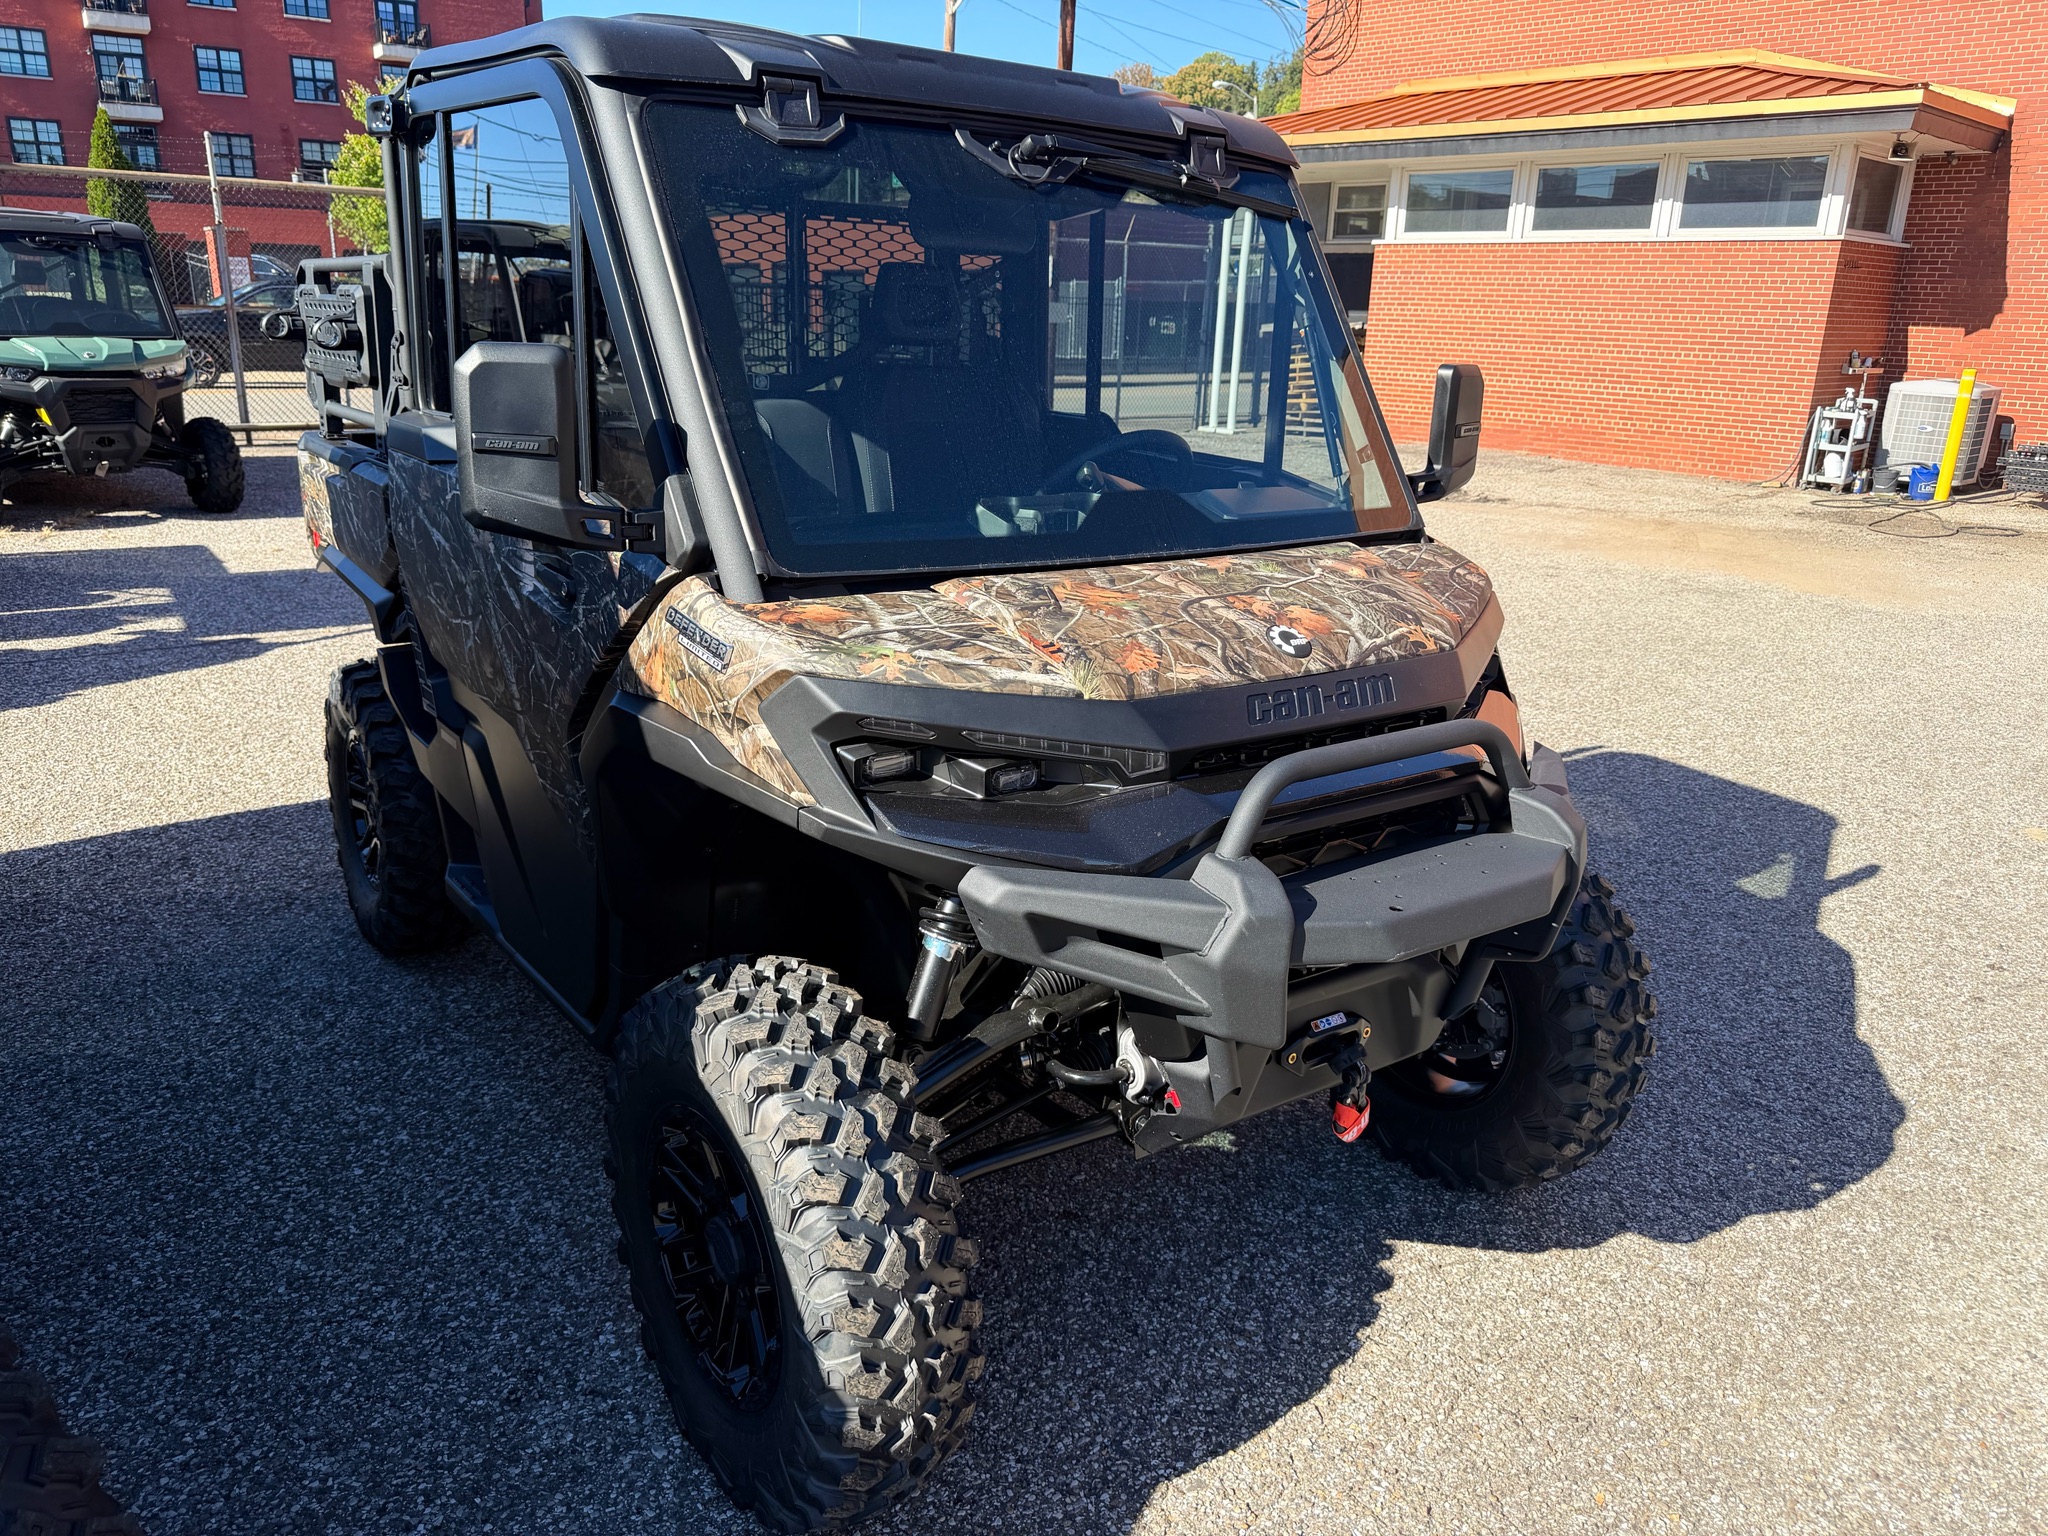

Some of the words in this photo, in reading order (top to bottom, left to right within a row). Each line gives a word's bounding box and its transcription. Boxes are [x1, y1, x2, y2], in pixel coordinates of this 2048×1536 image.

[485, 439, 540, 451] can-am
[666, 608, 727, 658] DEFENDER
[1290, 637, 1308, 647] BRP
[680, 637, 720, 668] LIMITED
[1246, 672, 1397, 727] can-am
